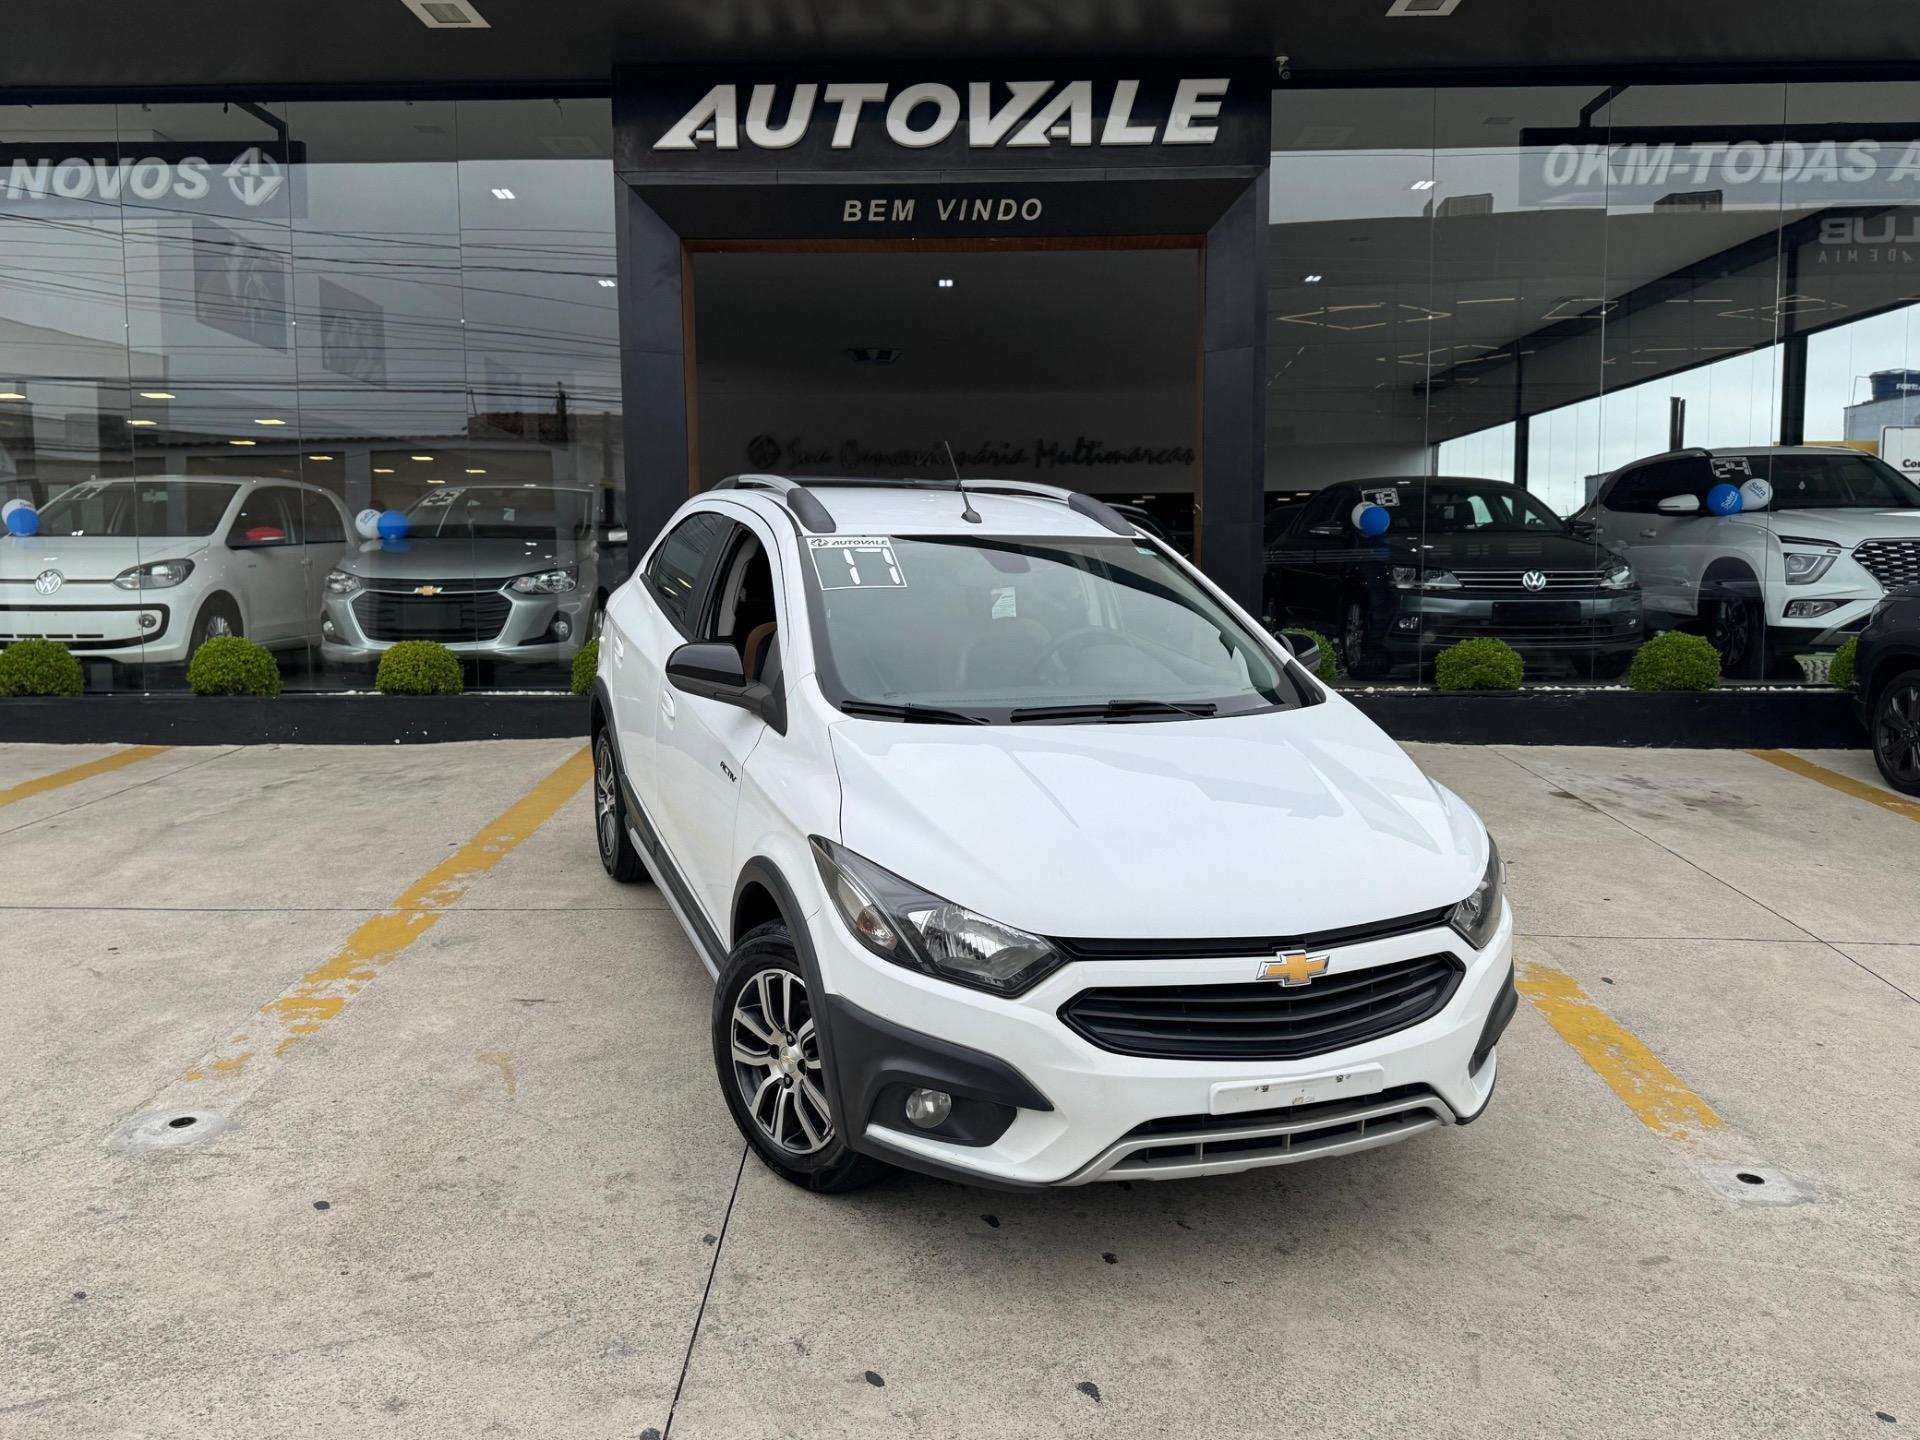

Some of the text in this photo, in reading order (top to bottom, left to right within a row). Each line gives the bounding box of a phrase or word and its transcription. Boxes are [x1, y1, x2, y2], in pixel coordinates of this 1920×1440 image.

[652, 78, 1231, 149] AUTOVALE
[842, 197, 1043, 222] BEM VINDO
[843, 547, 901, 585] 17
